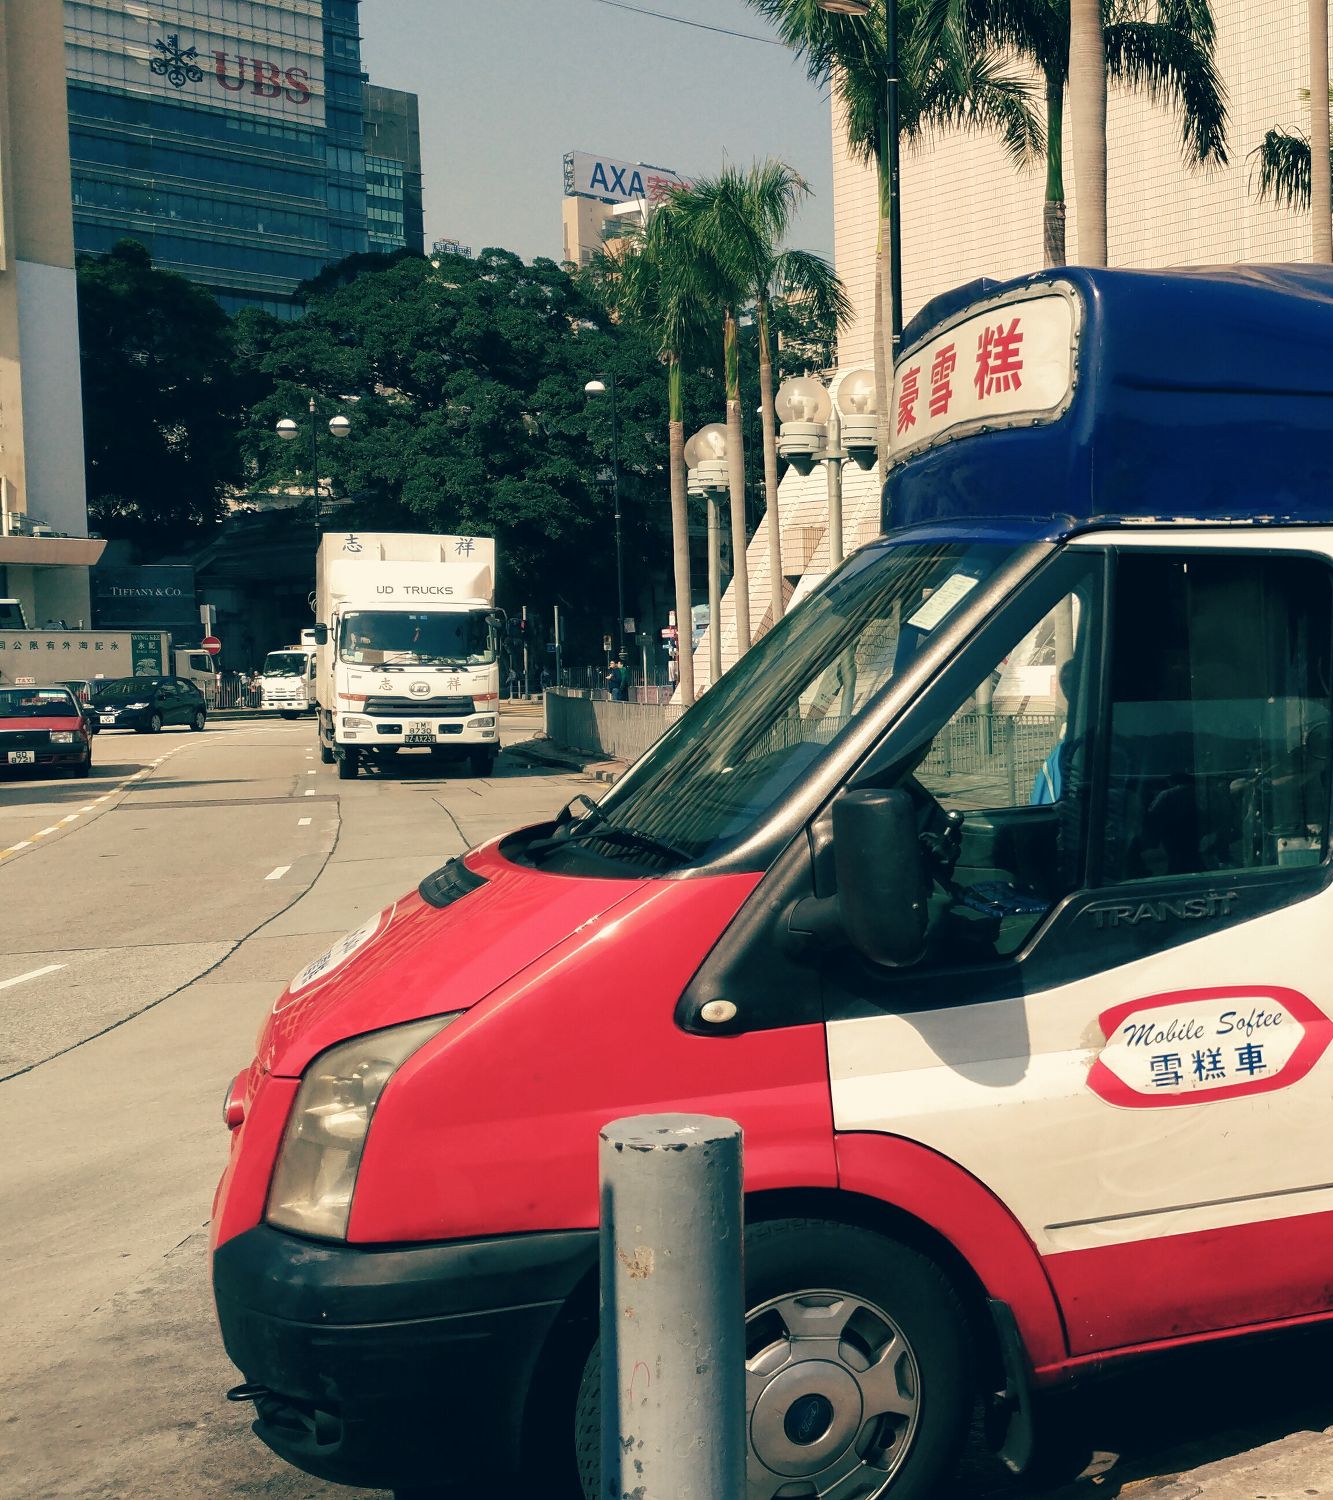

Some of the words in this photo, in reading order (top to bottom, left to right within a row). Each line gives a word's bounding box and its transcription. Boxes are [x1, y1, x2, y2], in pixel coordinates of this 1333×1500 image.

[211, 50, 310, 105] UBS
[590, 162, 646, 199] AXA
[897, 318, 1024, 436] 豪雪糕
[342, 533, 363, 553] 志
[454, 537, 476, 558] 祥
[376, 586, 394, 594] UD
[403, 586, 454, 595] TRUCKS
[1088, 889, 1239, 929] TRANSIT
[1123, 1019, 1205, 1047] Mobile
[1216, 1008, 1283, 1038] Softee
[1149, 1042, 1267, 1087] 雪糕車
